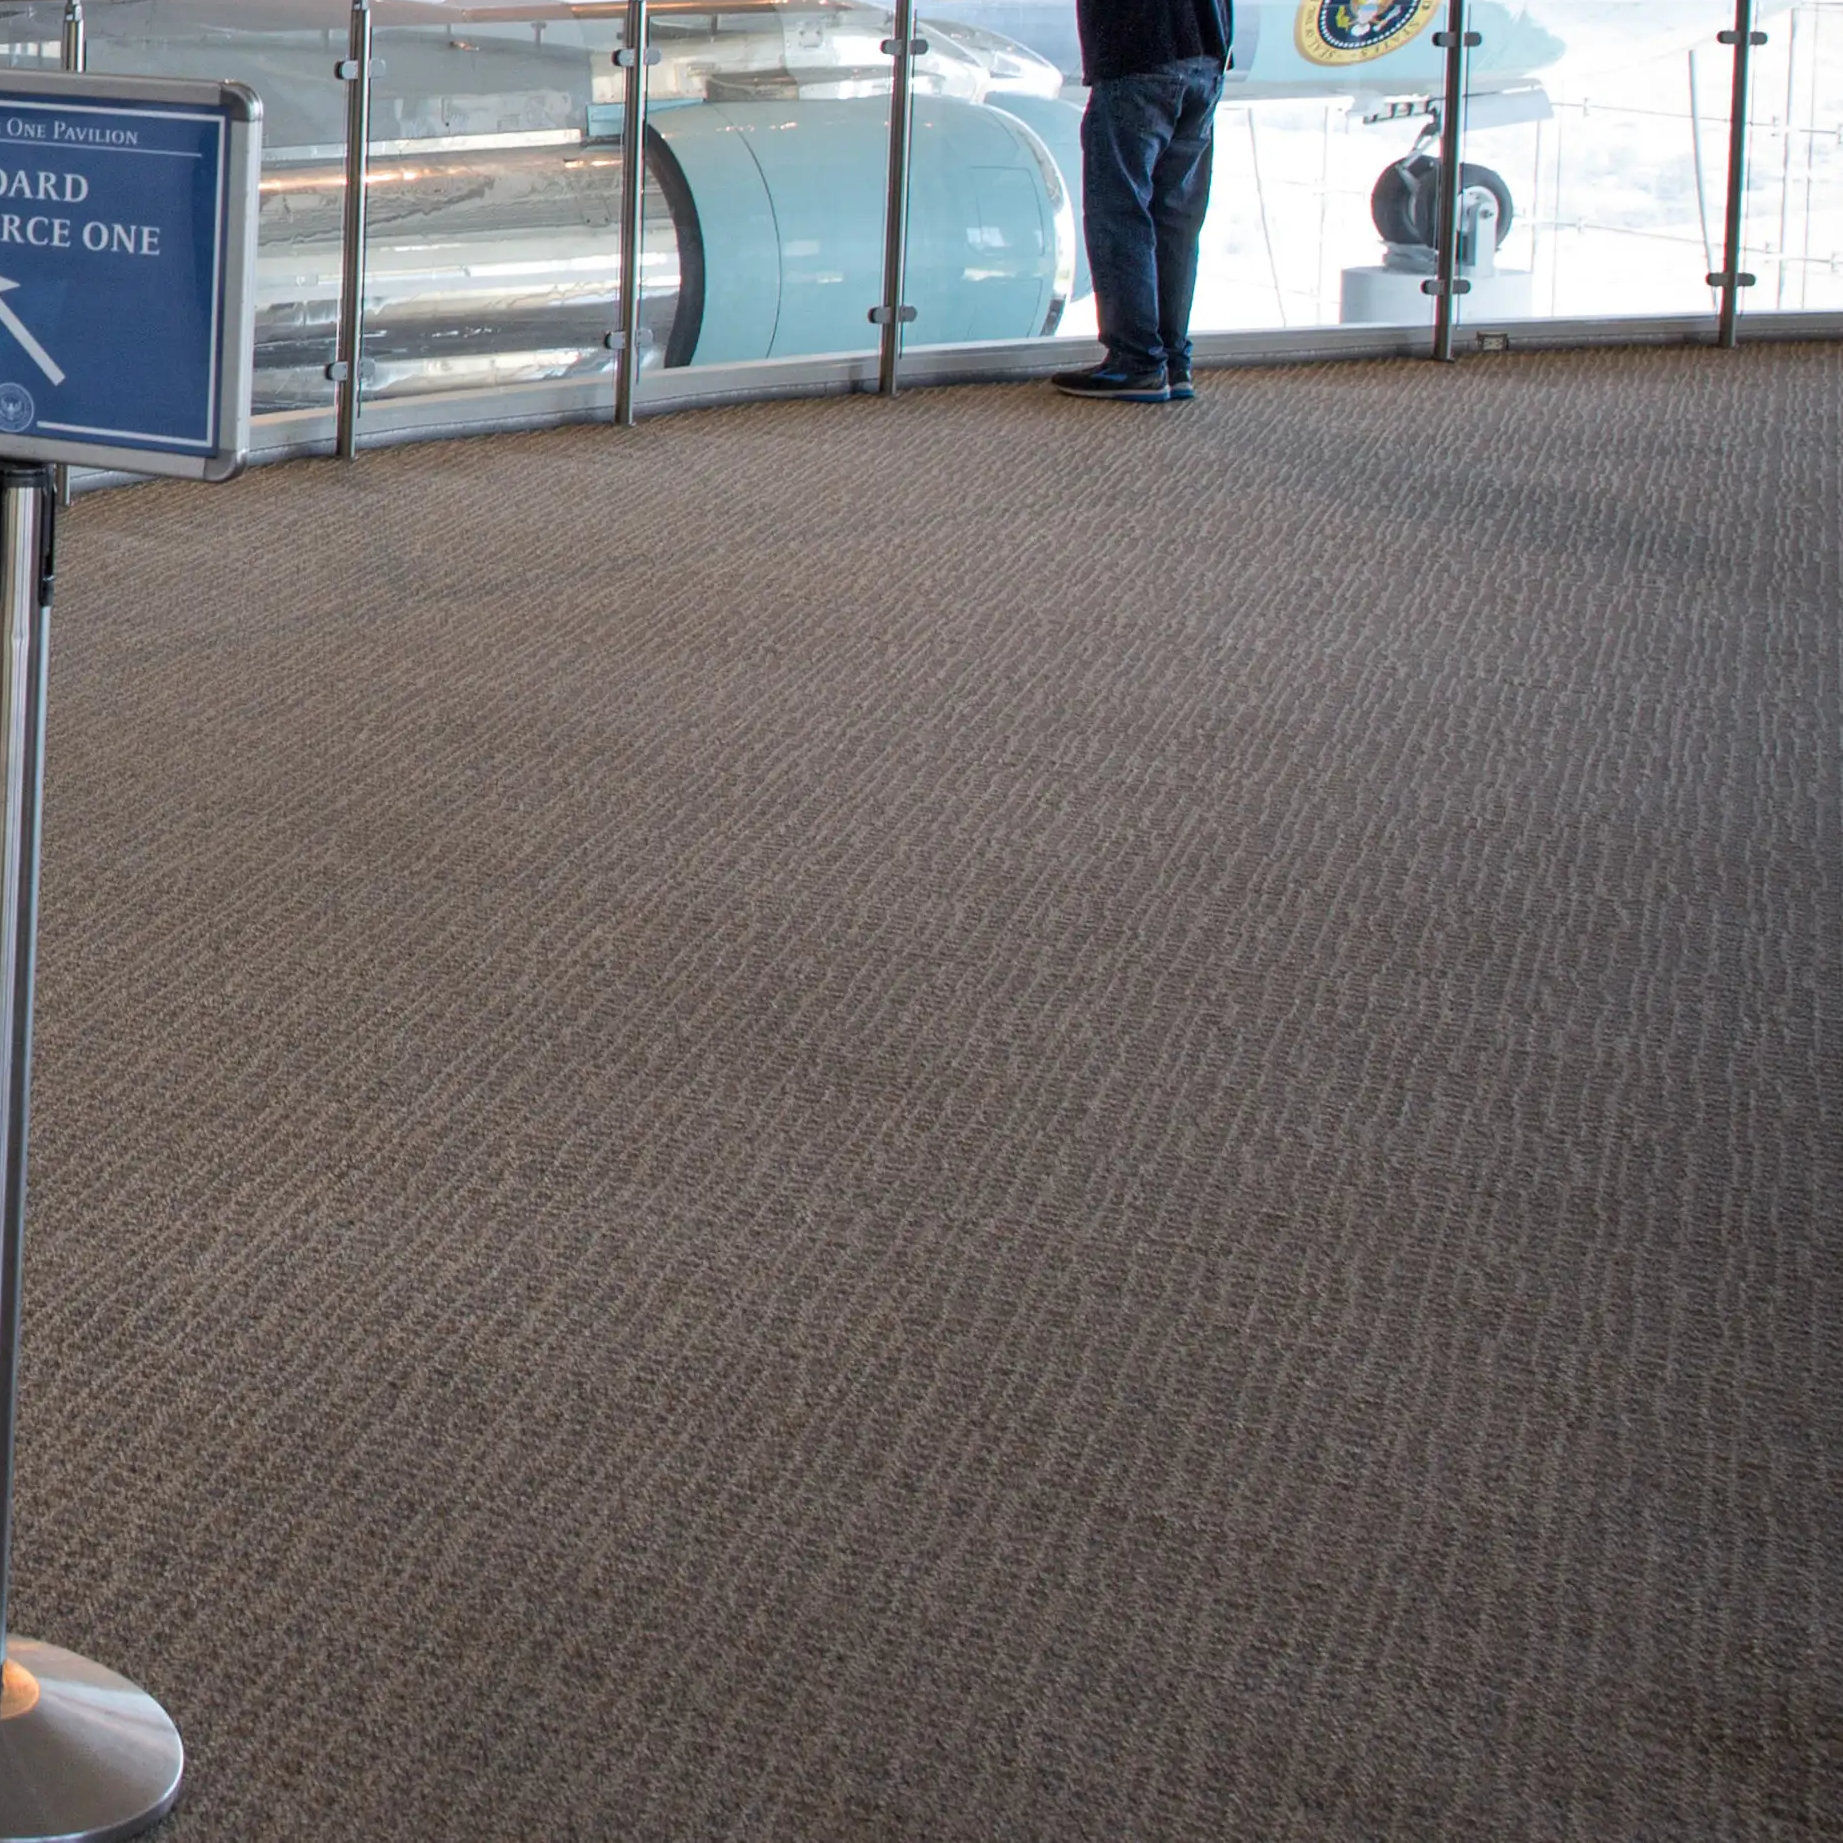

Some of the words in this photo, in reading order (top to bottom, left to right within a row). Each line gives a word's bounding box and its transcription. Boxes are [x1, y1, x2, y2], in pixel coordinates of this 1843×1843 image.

[6, 116, 46, 139] ONE
[53, 120, 139, 146] PAVILION
[82, 221, 161, 256] ONE
